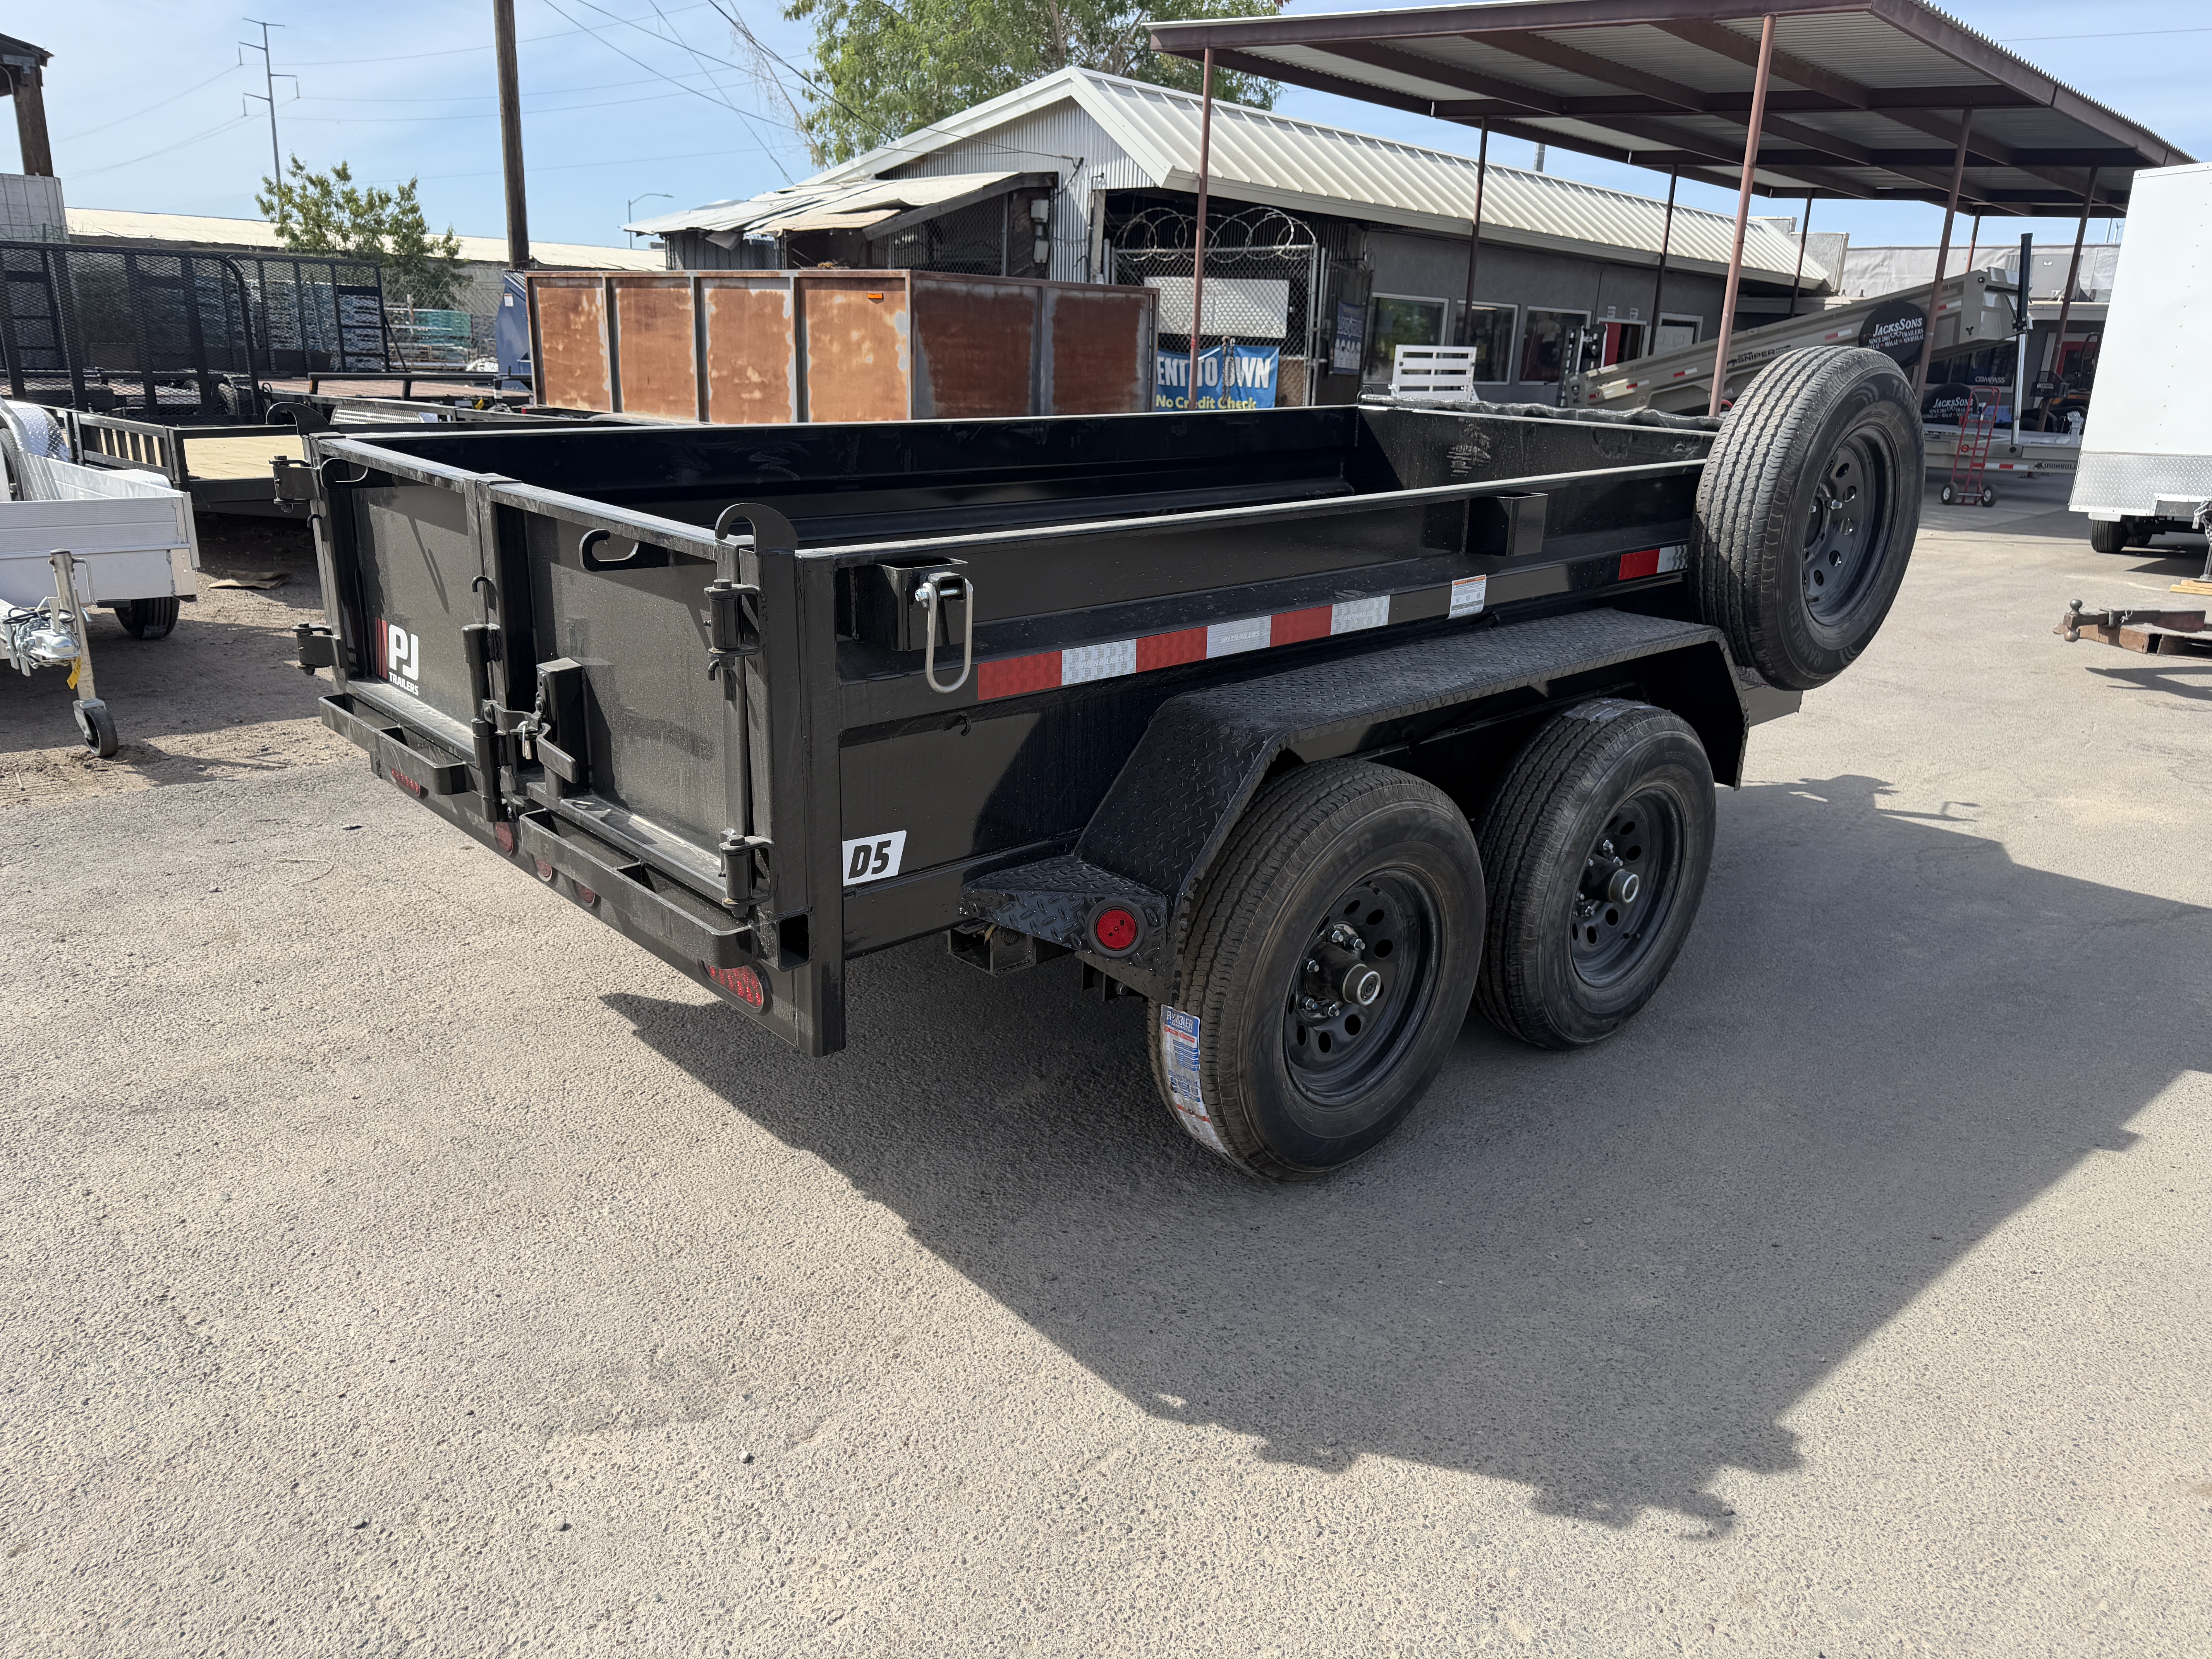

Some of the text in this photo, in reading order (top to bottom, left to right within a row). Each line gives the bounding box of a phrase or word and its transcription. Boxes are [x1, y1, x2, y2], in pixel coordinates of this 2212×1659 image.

[1902, 328, 1924, 338] TRAILERS
[1737, 349, 1776, 363] SNIPER
[1157, 356, 1271, 388] ENT TO OWN
[1156, 395, 1174, 408] No
[1175, 396, 1216, 409] Crdit
[1789, 600, 1823, 667] RAMBLER
[389, 624, 419, 680] PJ
[389, 672, 419, 696] TRAILERS
[848, 840, 892, 879] D5
